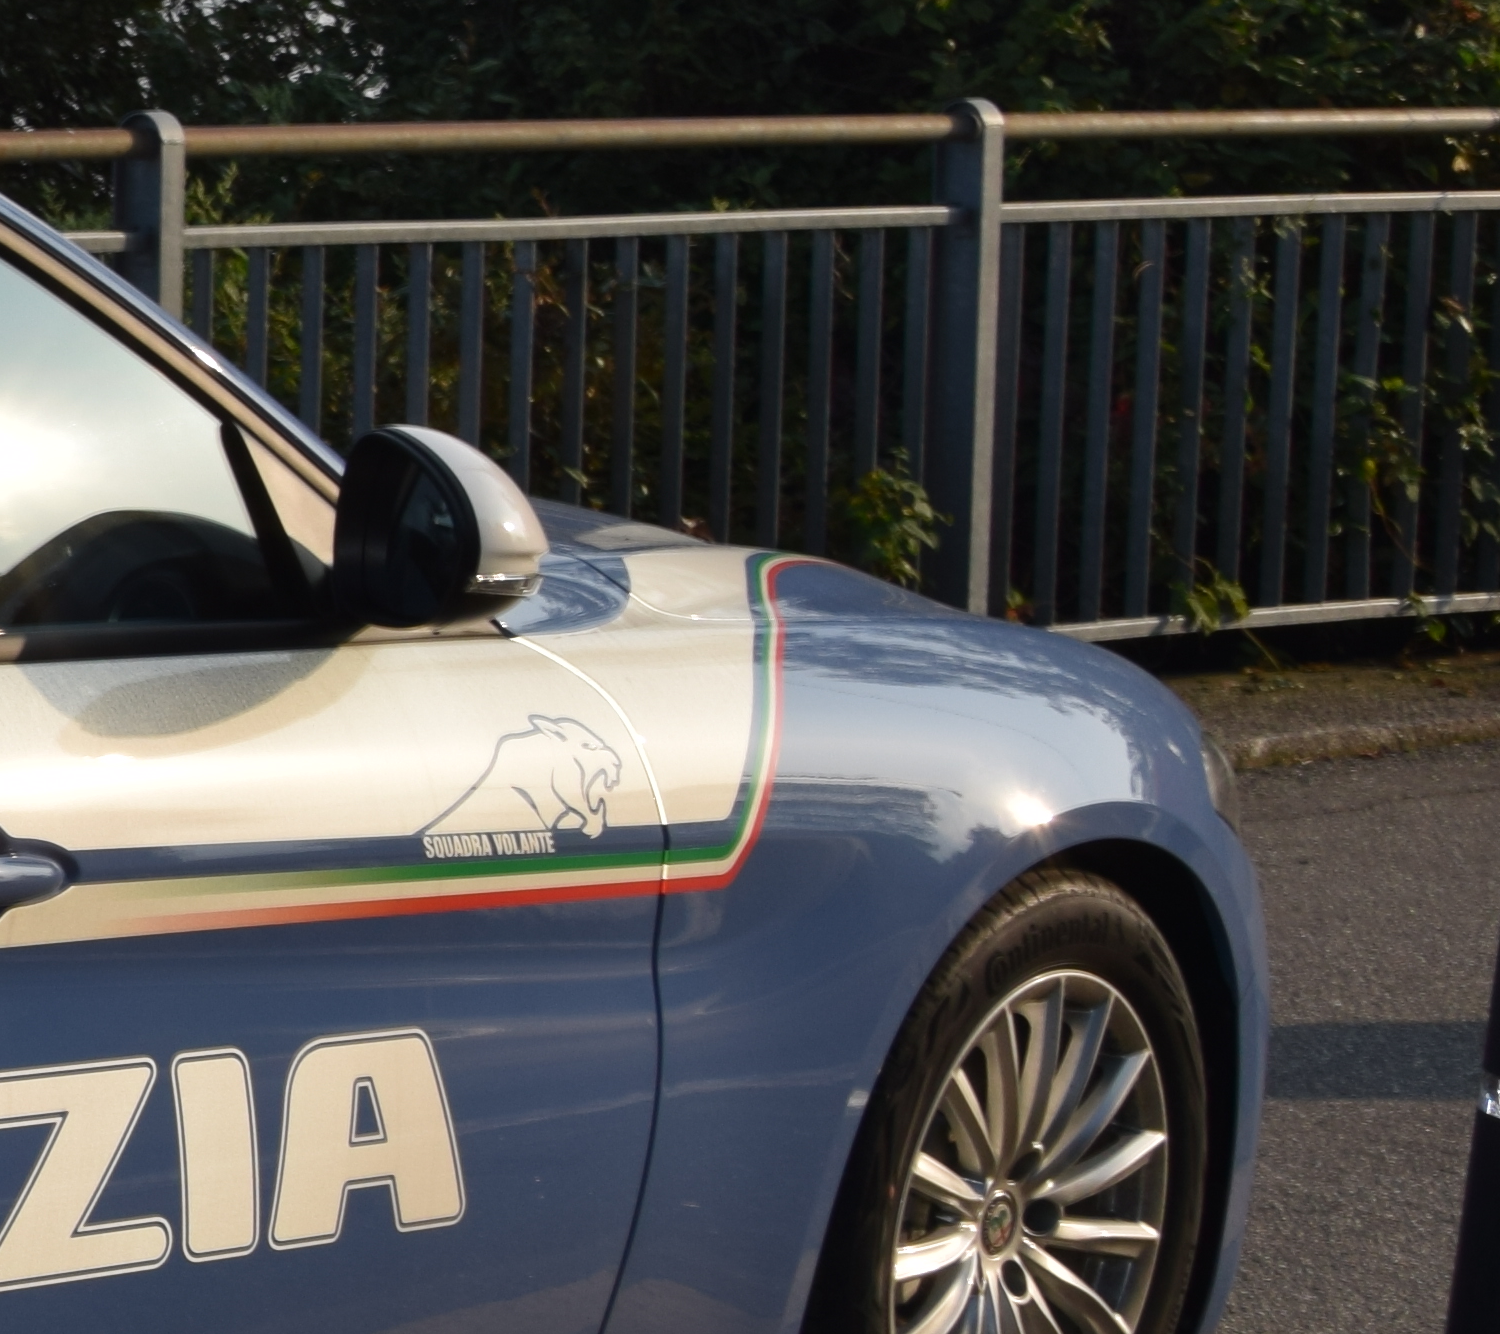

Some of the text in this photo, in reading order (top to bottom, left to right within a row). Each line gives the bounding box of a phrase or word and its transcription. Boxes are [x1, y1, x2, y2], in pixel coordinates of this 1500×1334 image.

[423, 831, 555, 859] SQUADRA VOLANTE
[984, 911, 1109, 997] Continental
